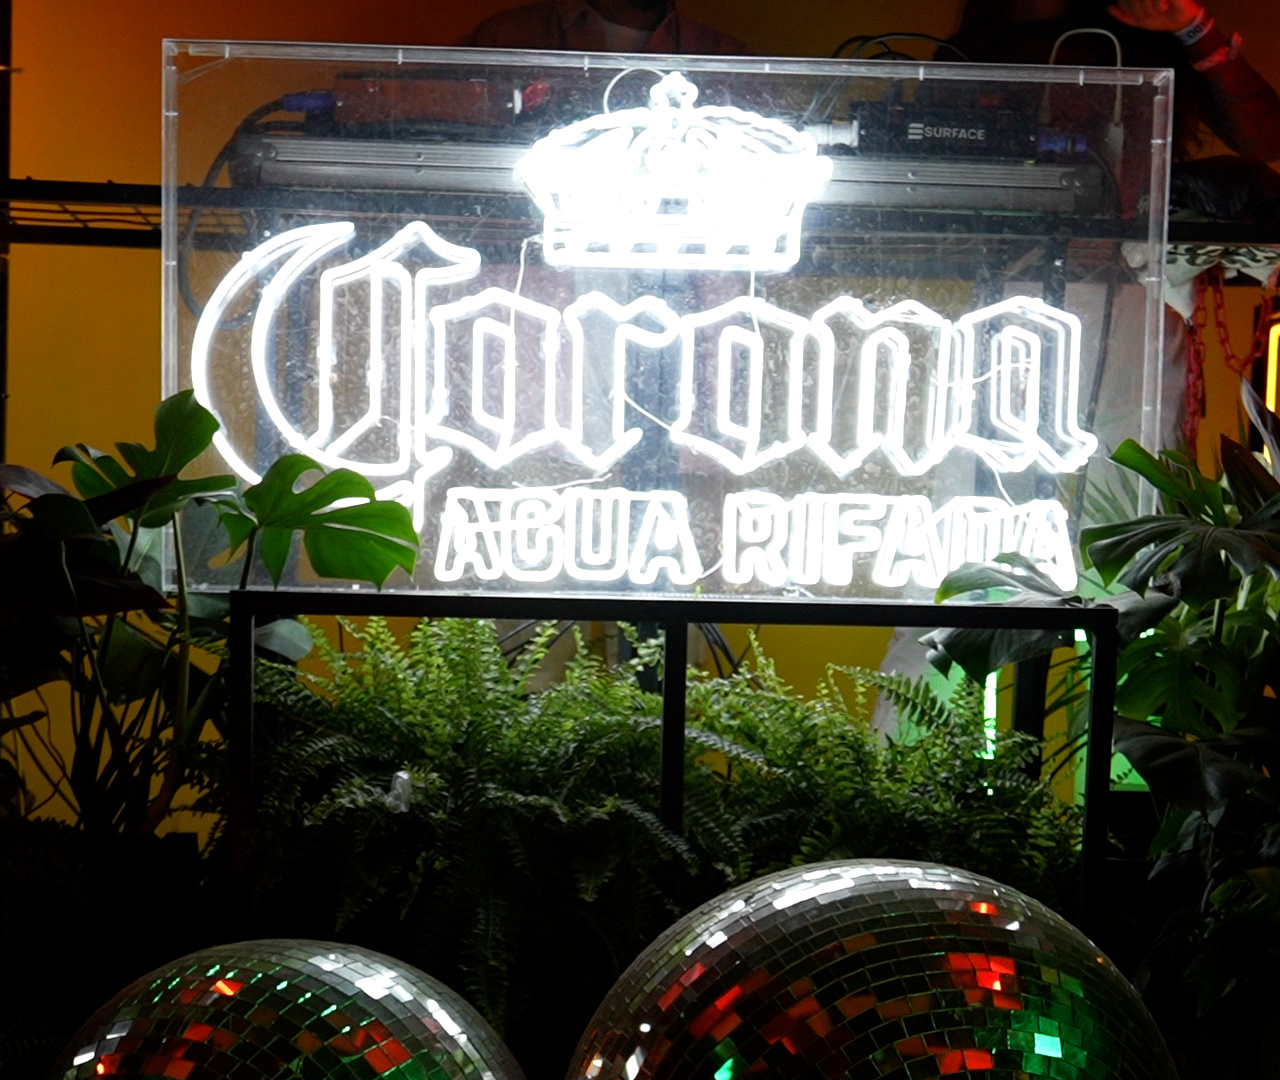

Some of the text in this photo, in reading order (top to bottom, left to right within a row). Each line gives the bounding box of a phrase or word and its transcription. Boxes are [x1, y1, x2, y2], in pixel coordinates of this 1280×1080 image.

[924, 126, 987, 141] SURFACE
[190, 221, 1099, 533] Corona
[434, 487, 701, 585] AGUA
